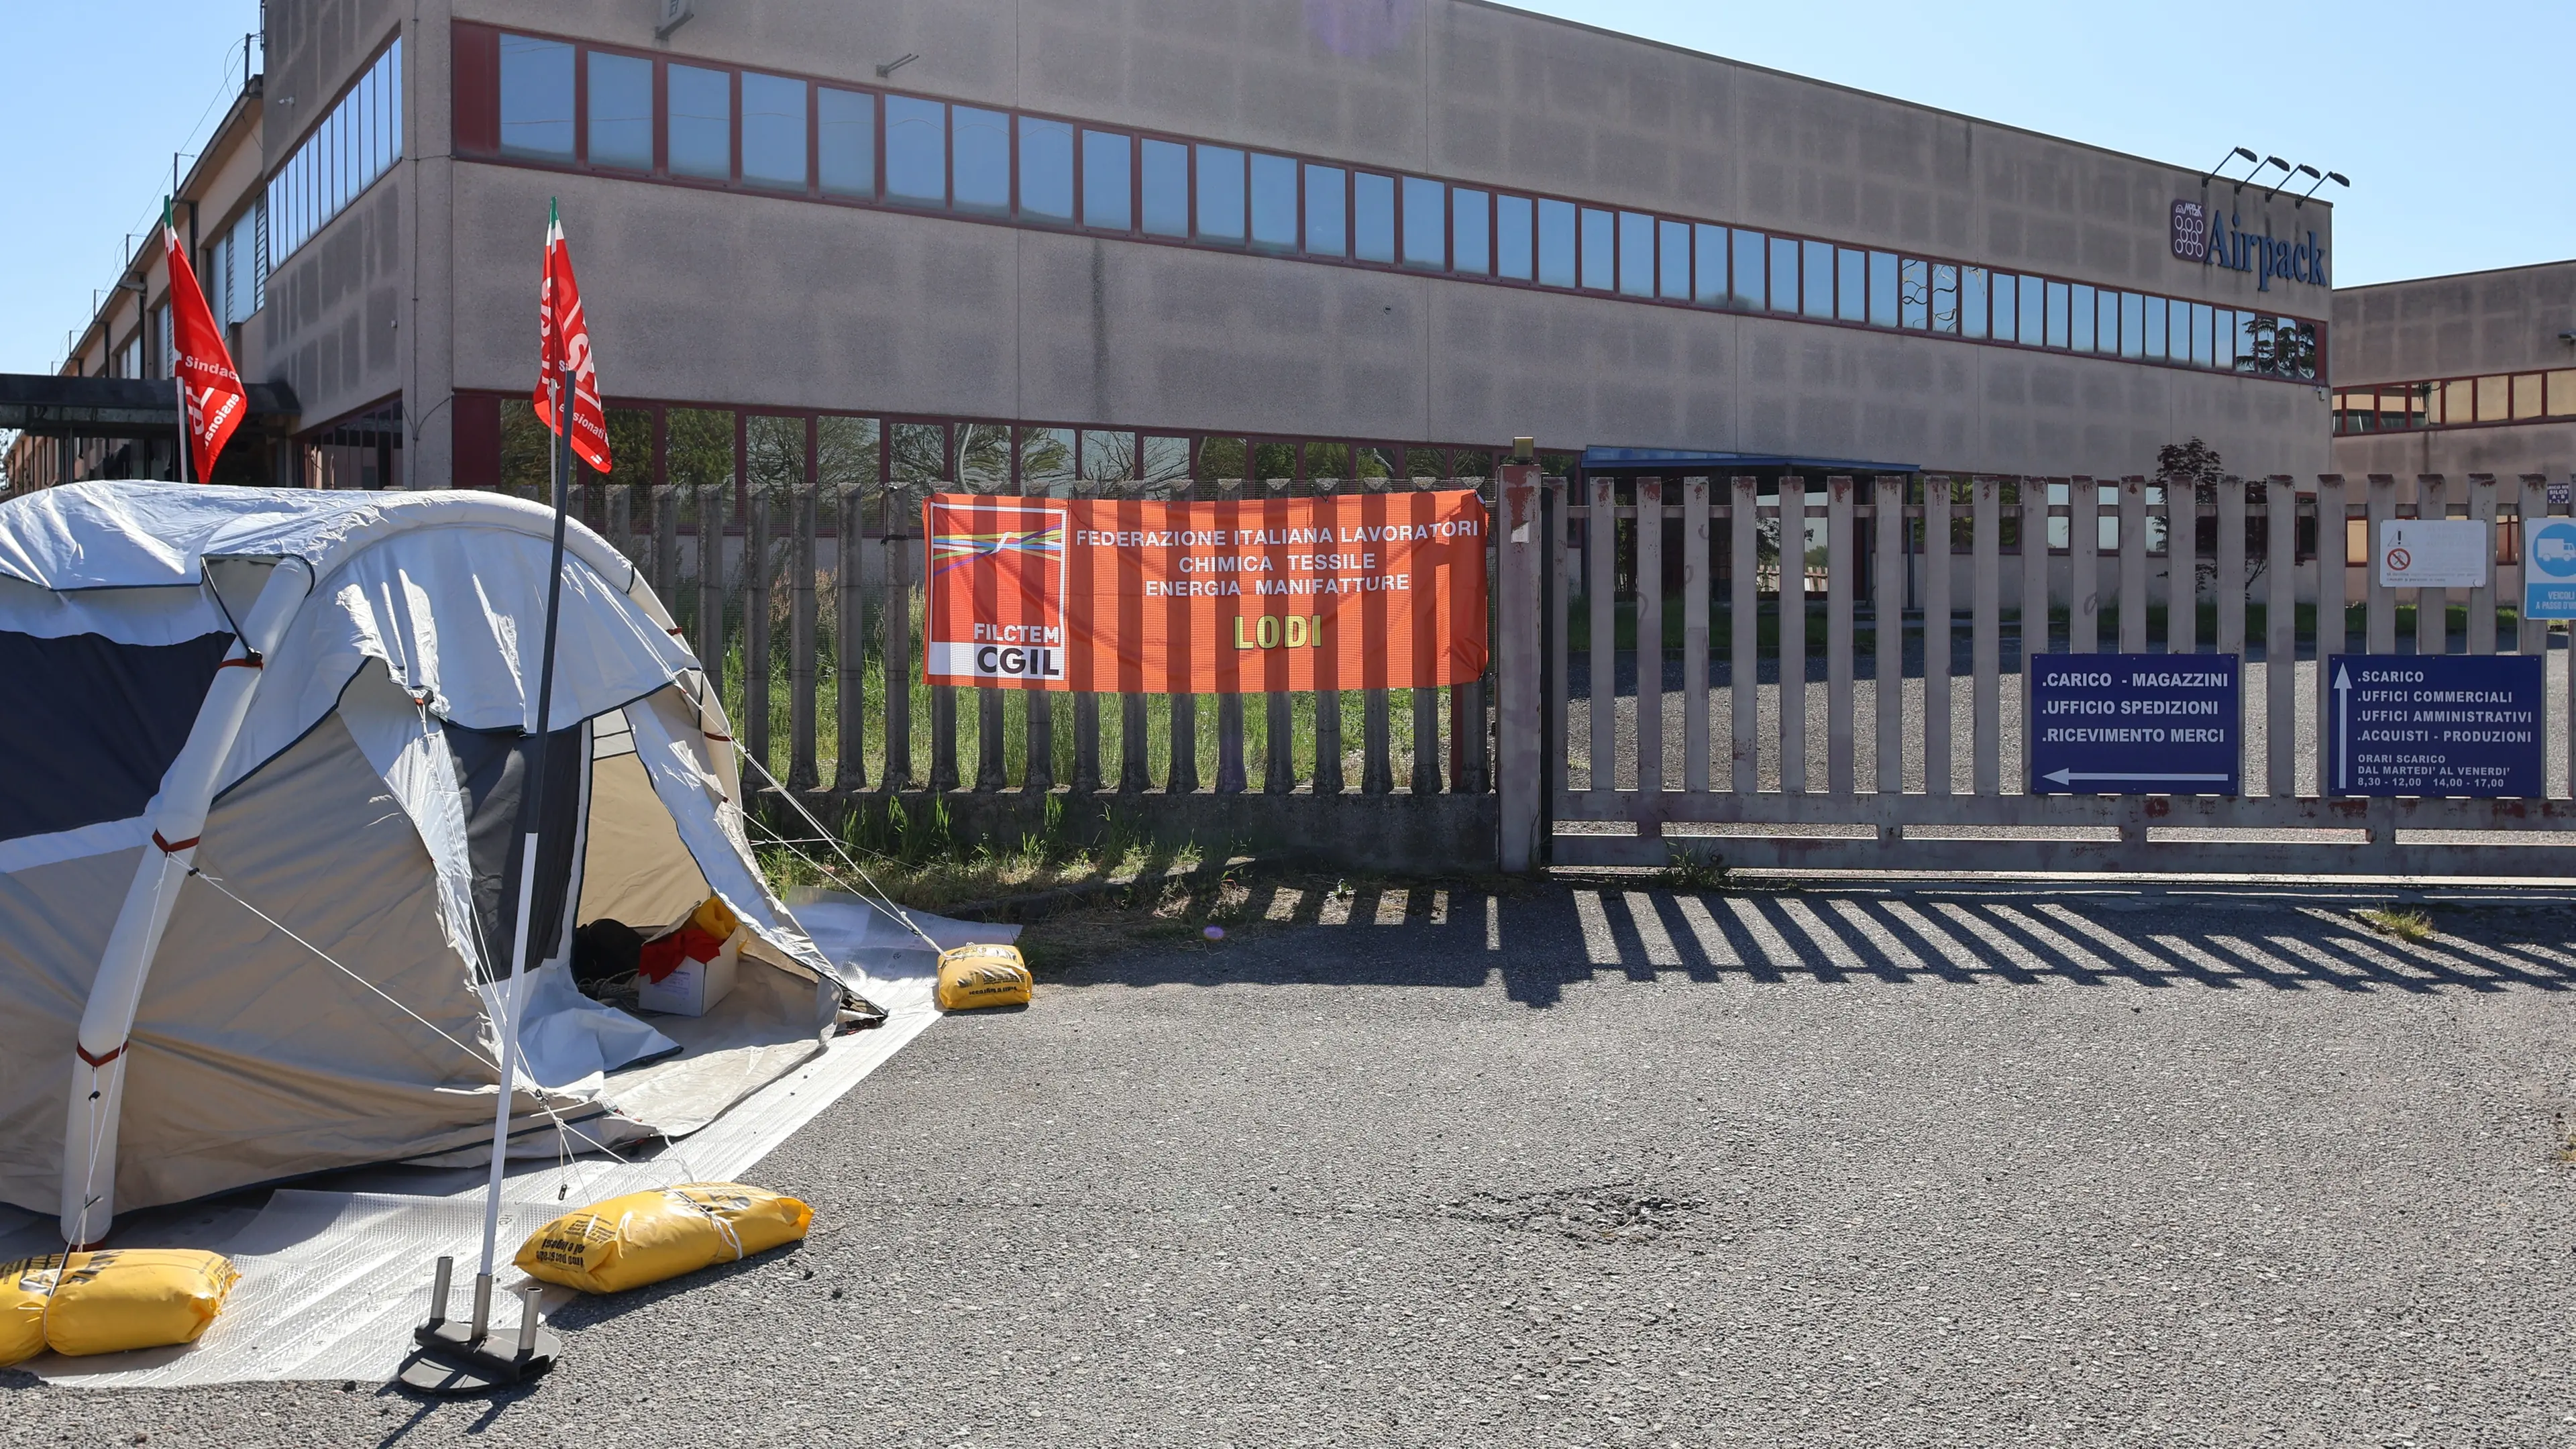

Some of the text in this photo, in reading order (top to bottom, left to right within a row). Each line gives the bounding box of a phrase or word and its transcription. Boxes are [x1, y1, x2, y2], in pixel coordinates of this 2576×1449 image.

[2204, 209, 2327, 292] Airpack
[1076, 520, 1479, 547] FEDERAZIONE ITALIANA LAVORATORI
[1179, 553, 1376, 573] CHIMICA TESSILE
[1145, 574, 1409, 596] ENERGIA MANIFATTURE
[2548, 591, 2575, 600] VEICOLI
[2536, 601, 2540, 610] A
[973, 623, 1060, 644] FILCTEM
[1233, 614, 1322, 650] LODI
[977, 645, 1060, 676] CGIL
[2132, 673, 2228, 687] MAGAZZINI
[2413, 691, 2512, 702] COMMERCIALI
[2121, 701, 2218, 714] SPEDIZIONI
[2413, 711, 2532, 722] AMMINISTRATIVI
[2171, 729, 2224, 742] MERCI
[2444, 731, 2531, 743] PRODUZIONI
[2358, 754, 2445, 763] ORARI SCARICO
[2358, 766, 2379, 775] DAL
[2439, 767, 2453, 775] AL
[2357, 777, 2381, 787] 8,30
[2392, 778, 2422, 788] 12,00
[2432, 778, 2463, 788] 14,00
[2474, 779, 2504, 788] 17,00
